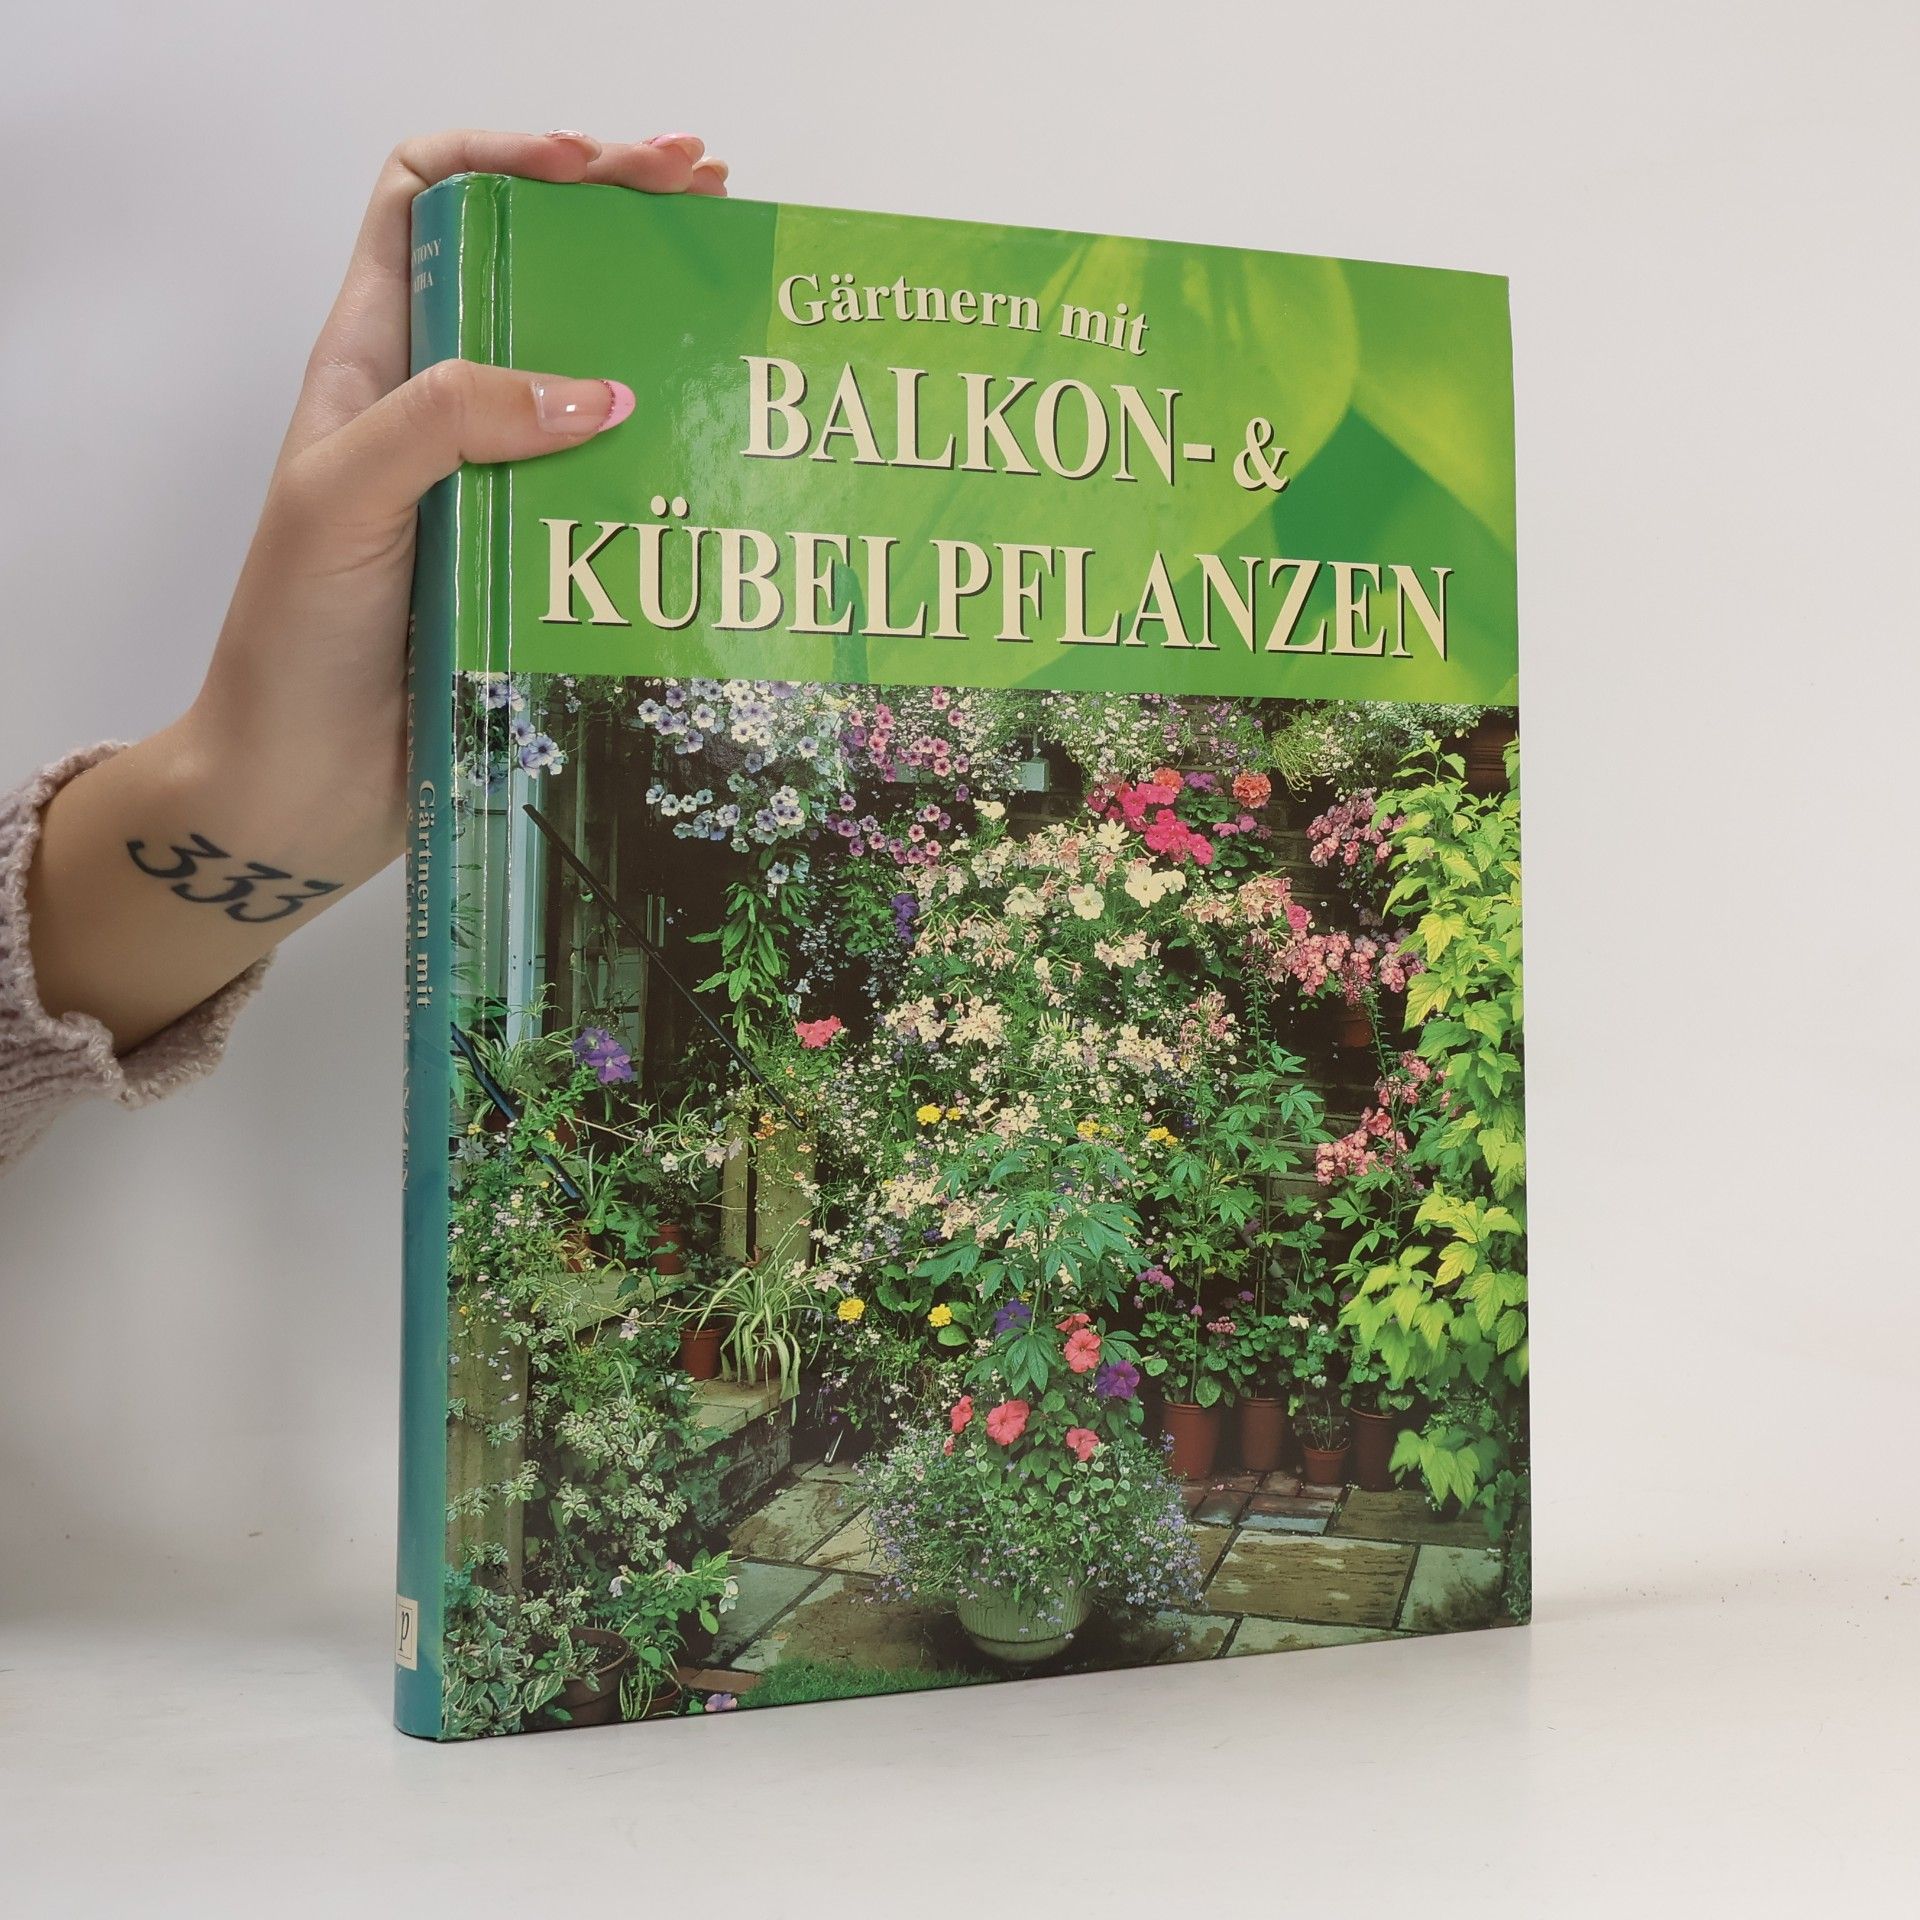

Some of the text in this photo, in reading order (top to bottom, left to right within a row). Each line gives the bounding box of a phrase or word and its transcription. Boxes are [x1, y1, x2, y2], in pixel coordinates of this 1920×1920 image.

[777, 273, 1149, 355] Gärtnern mit
[739, 354, 1289, 492] BALKON- &
[539, 494, 1453, 663] KÜBELPFLANZEN
[126, 833, 345, 923] 333
[416, 780, 436, 1009] Gärtnern mit
